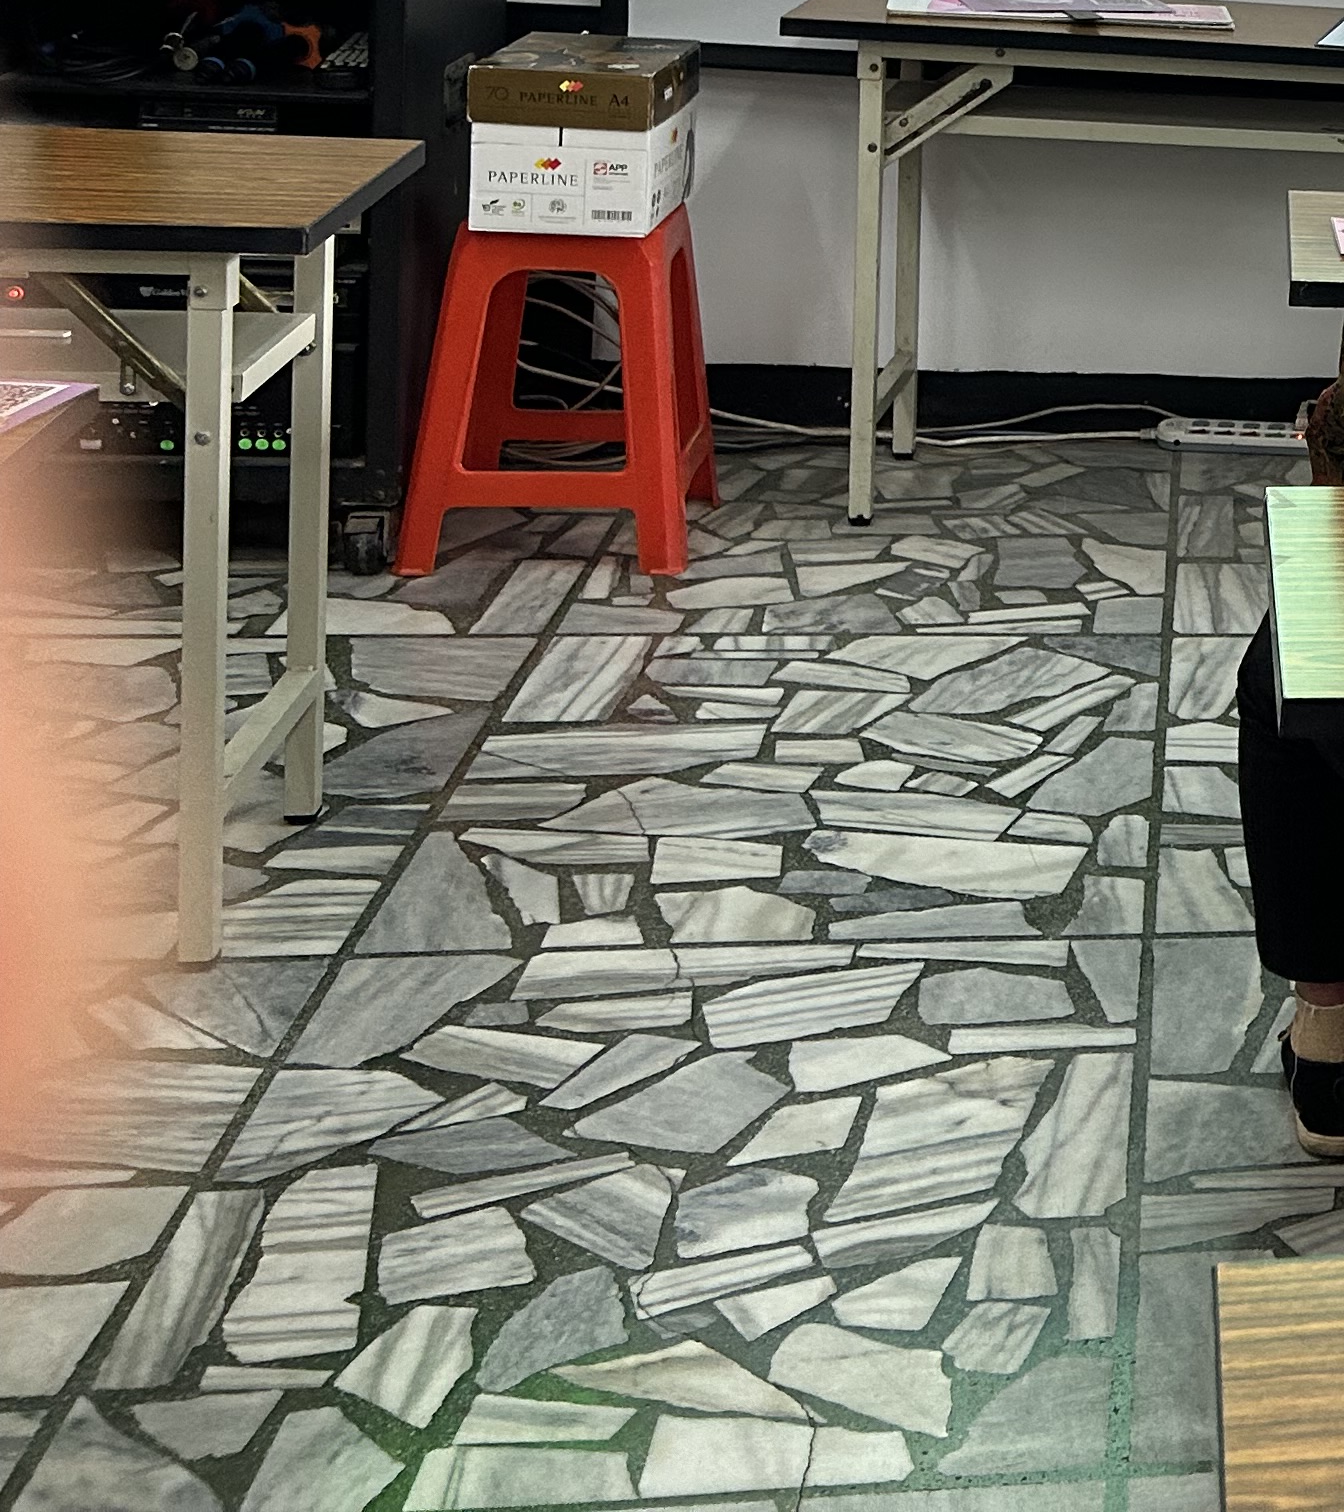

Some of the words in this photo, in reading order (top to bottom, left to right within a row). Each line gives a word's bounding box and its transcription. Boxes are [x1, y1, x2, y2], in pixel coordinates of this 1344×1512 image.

[519, 91, 597, 105] PAPERLINE
[609, 94, 629, 107] A4
[609, 163, 628, 172] APP
[488, 170, 579, 187] PAPERLINE
